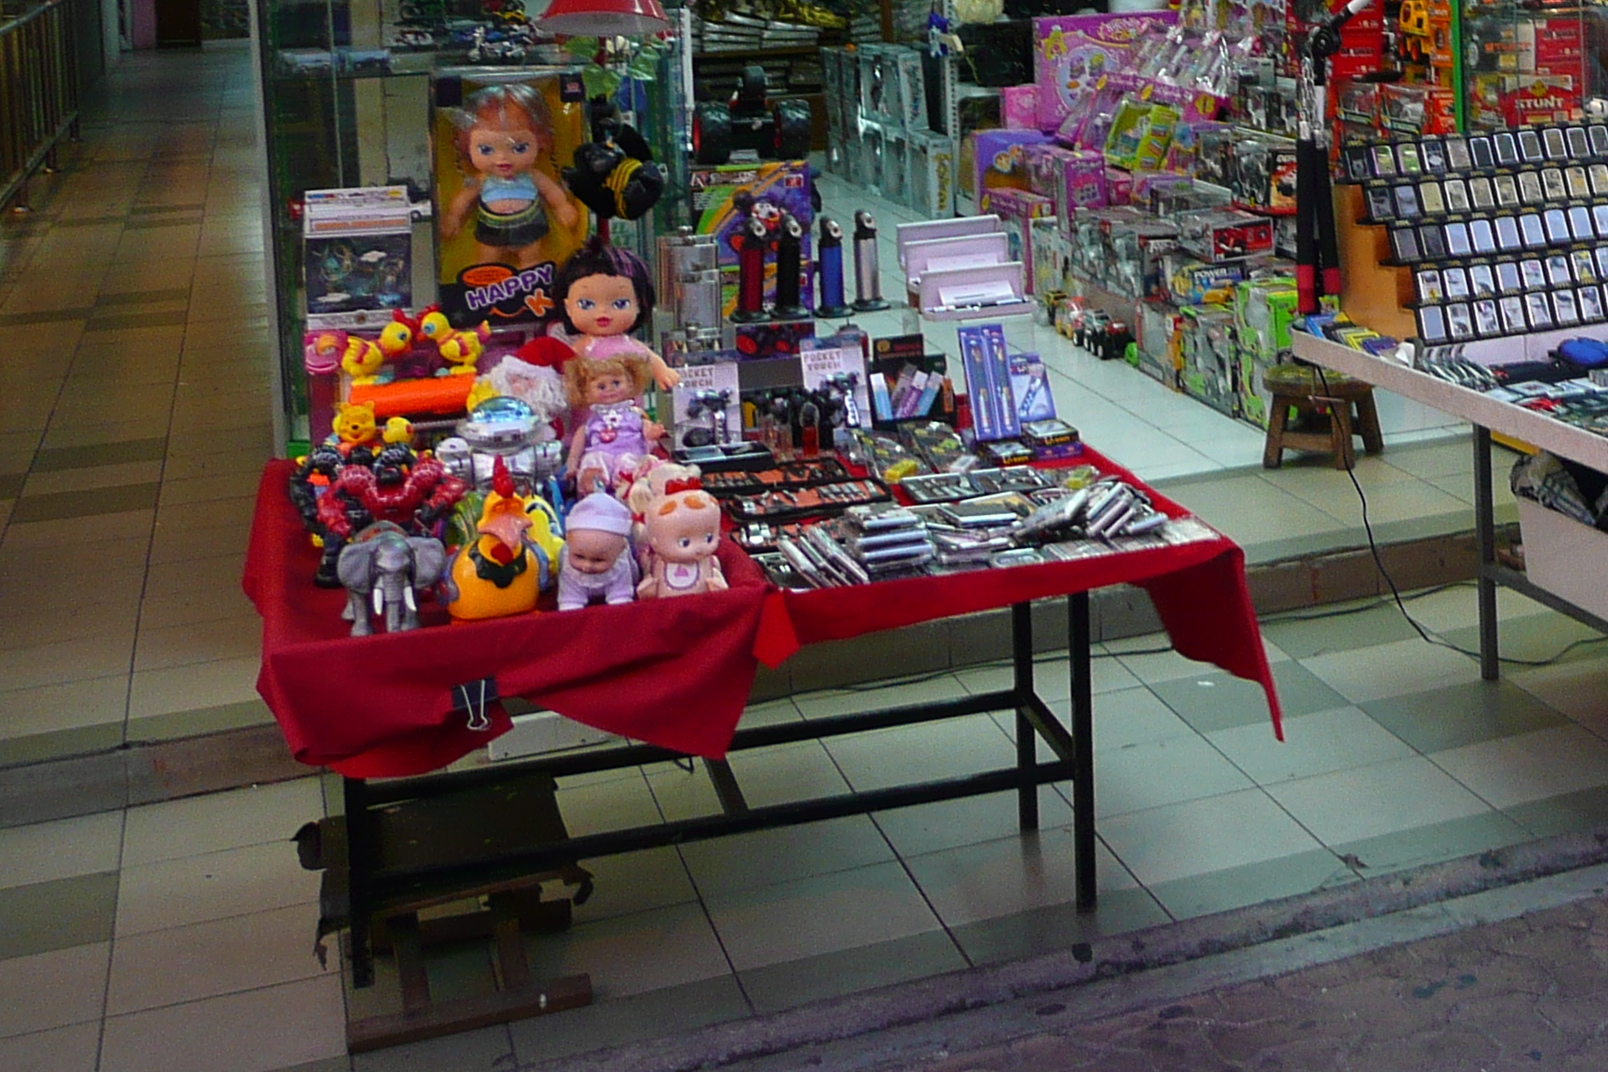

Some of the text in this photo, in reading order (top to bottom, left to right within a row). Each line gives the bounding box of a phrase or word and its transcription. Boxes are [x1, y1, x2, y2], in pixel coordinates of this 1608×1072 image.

[1514, 95, 1565, 110] STUNT
[464, 263, 553, 311] HAPPY
[678, 366, 715, 379] OCKET
